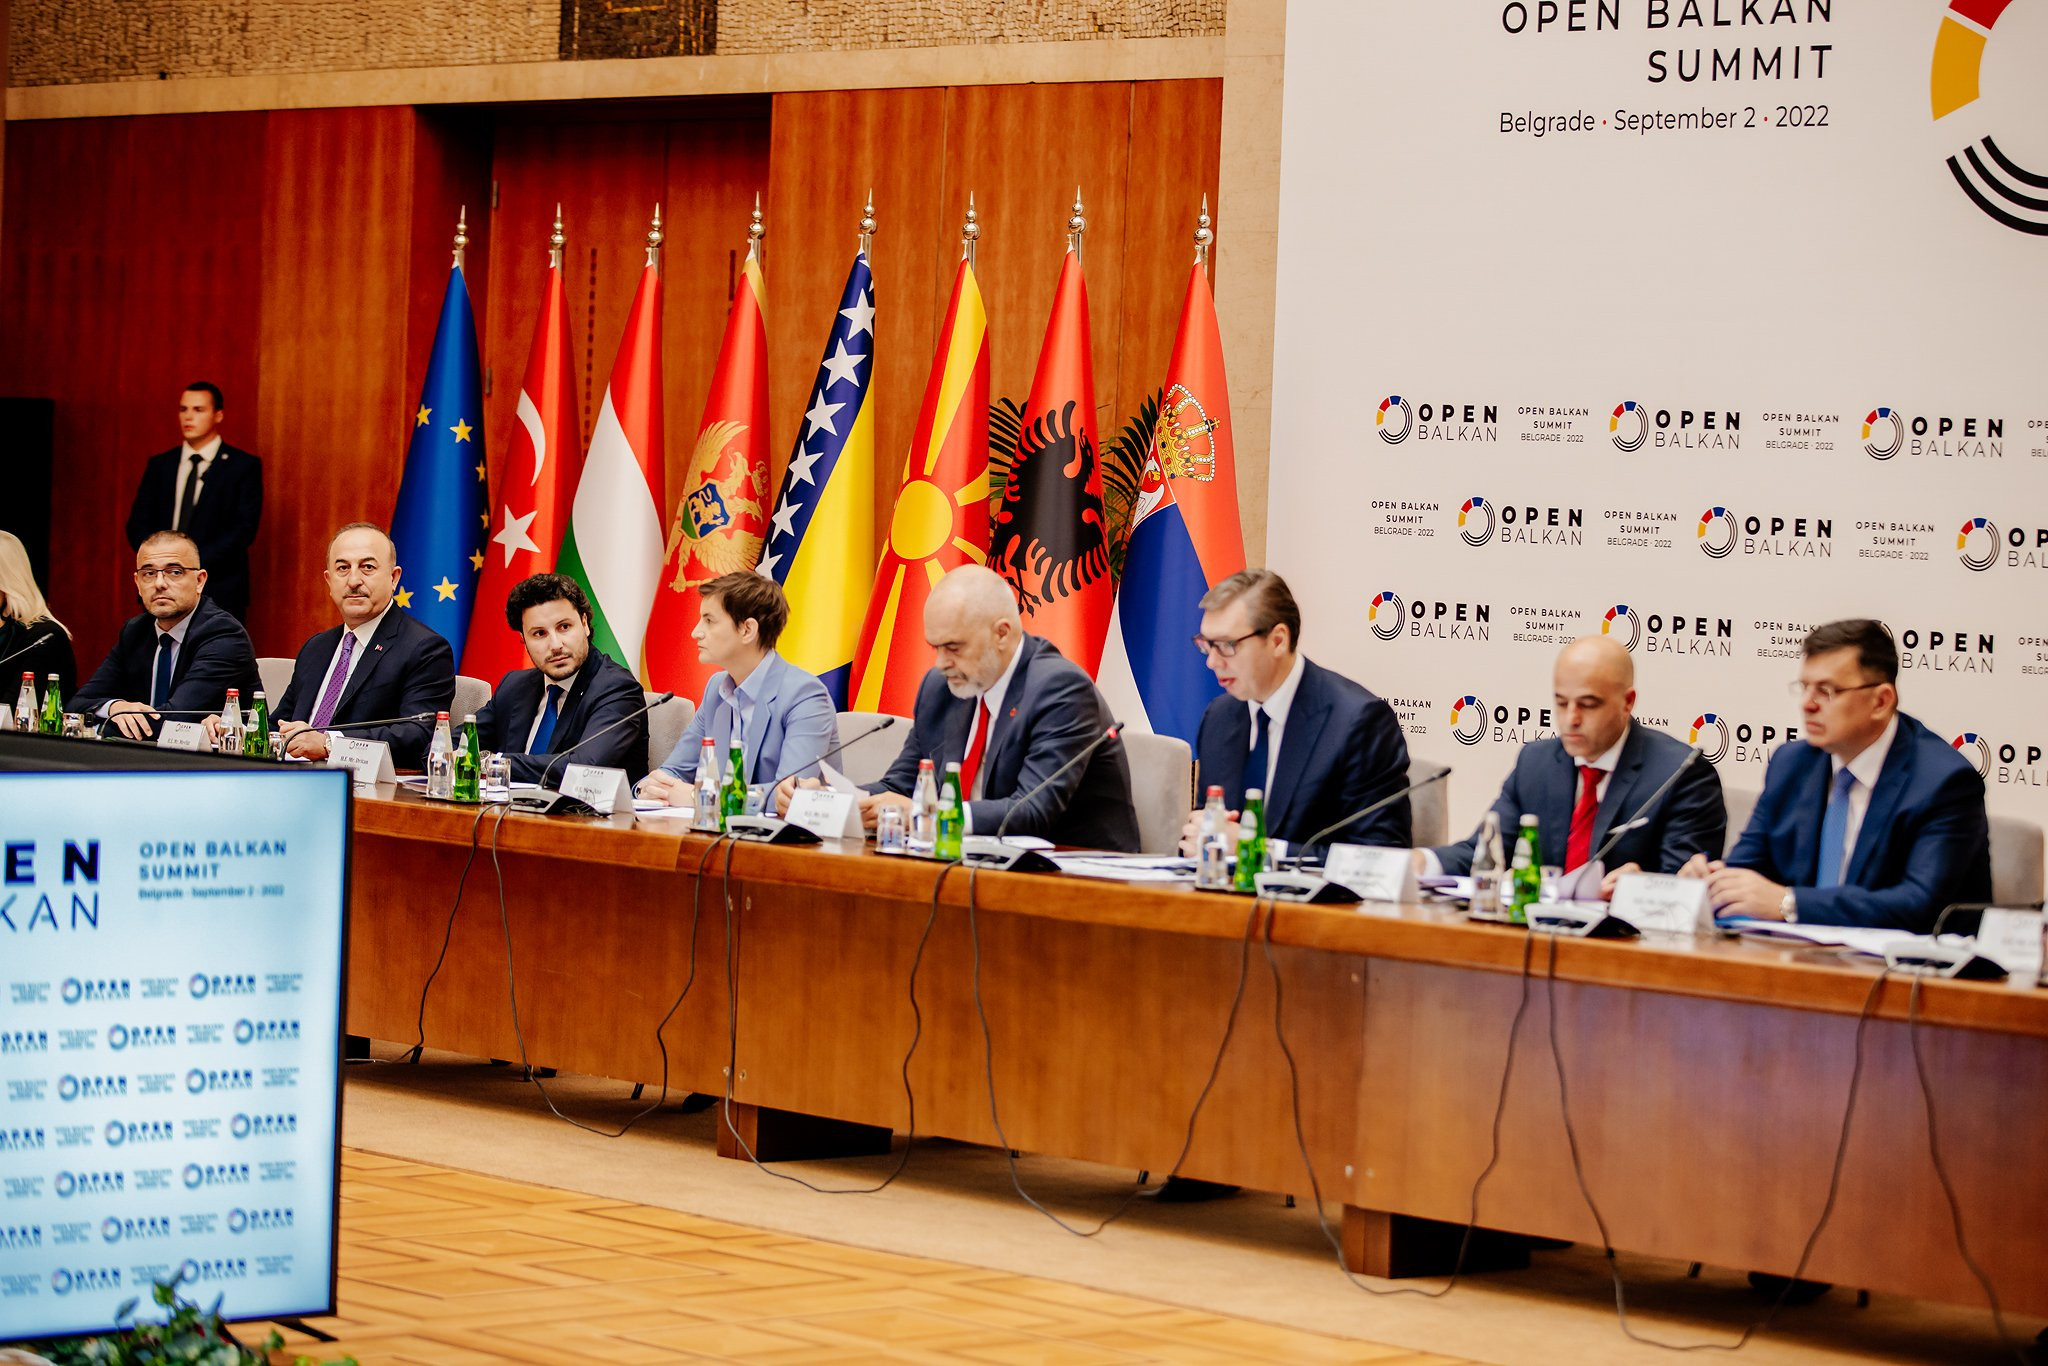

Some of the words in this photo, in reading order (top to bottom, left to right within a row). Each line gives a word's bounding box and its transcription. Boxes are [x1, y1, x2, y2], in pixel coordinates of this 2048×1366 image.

[1501, 0, 1620, 34] OPEN
[1647, 0, 1831, 29] BALKAN
[1647, 44, 1833, 83] SUMMIT
[1500, 110, 1595, 138] Belgrade
[1614, 107, 1737, 136] September
[1743, 107, 1756, 129] 2
[1775, 105, 1829, 128] 2022
[1418, 403, 1498, 424] OPEN
[1518, 406, 1545, 415] OPEN
[1549, 407, 1589, 417] BALKAN
[1763, 413, 1791, 422] OPEN
[1797, 414, 1839, 423] BALKAN
[1533, 420, 1573, 430] SUMMIT
[1655, 409, 1740, 430] OPEN
[2027, 420, 2048, 429] OPE
[1418, 425, 1498, 442] BALKAN
[1779, 428, 1821, 437] SUMMIT
[1911, 416, 2003, 438] OPEN
[1520, 433, 1561, 442] BELGRADE
[1566, 434, 1584, 443] 2022
[1655, 431, 1740, 450] BALKAN
[1765, 440, 1809, 450] BELGRADE
[1815, 442, 1834, 450] 2022
[1911, 439, 2003, 458] BALKAN
[1371, 501, 1397, 510] OPEN
[1401, 502, 1439, 511] BALKAN
[1386, 515, 1424, 524] SUMMIT
[1501, 506, 1583, 527] OPEN
[1604, 511, 1632, 520] OPEN
[1636, 512, 1677, 521] BALKAN
[1374, 527, 1412, 537] BELGRADE
[1418, 528, 1434, 537] 2022
[1620, 525, 1660, 535] SUMMIT
[1745, 516, 1832, 538] OPEN
[1856, 521, 1885, 530] OPEN
[1890, 523, 1934, 533] BALKAN
[1501, 527, 1582, 546] BALKAN
[1607, 537, 1648, 547] BELGRADE
[1654, 539, 1672, 548] 2022
[1873, 536, 1916, 546] SUMMIT
[1744, 538, 1832, 558] BALKAN
[1858, 549, 1903, 560] BELGRADE
[1910, 551, 1929, 560] 2022
[1411, 600, 1490, 622] OPEN
[1510, 607, 1537, 616] OPEN
[1541, 609, 1581, 618] BALKAN
[1411, 622, 1490, 641] BALKAN
[1526, 621, 1564, 631] SUMMIT
[1647, 614, 1732, 637] OPEN
[1754, 621, 1783, 630] OPEN
[1788, 623, 1817, 633] BALK
[1513, 633, 1553, 643] BELGRADE
[1771, 636, 1803, 645] SUMM
[1903, 629, 1994, 653] OPEN
[1647, 636, 1732, 657] BALKAN
[1902, 652, 1994, 673] BALKAN
[1394, 698, 1432, 708] BALKAN
[1494, 705, 1551, 727] OPE
[1635, 716, 1669, 726] ALKAN
[1411, 725, 1427, 734] 2022
[1737, 723, 1798, 744] OPE
[139, 841, 196, 859] OPEN
[205, 840, 288, 857] BALKAN
[5, 838, 101, 886] EN
[138, 863, 221, 881] SUMMIT
[138, 887, 184, 901] Belgrade
